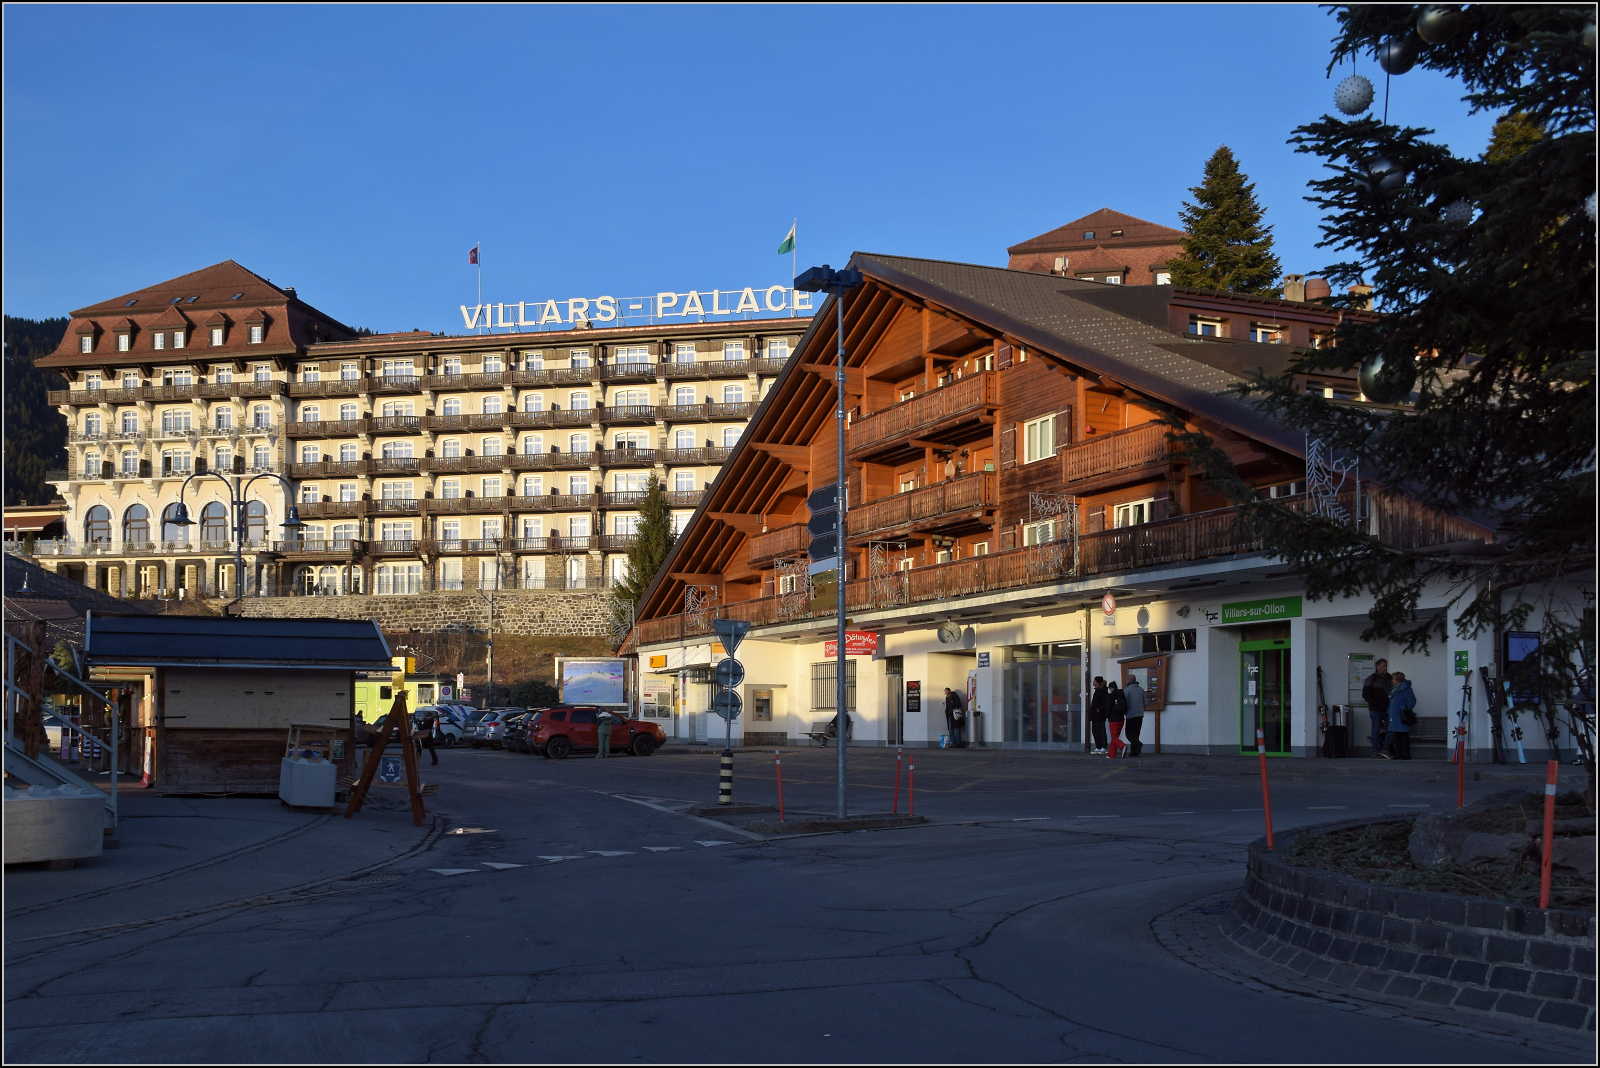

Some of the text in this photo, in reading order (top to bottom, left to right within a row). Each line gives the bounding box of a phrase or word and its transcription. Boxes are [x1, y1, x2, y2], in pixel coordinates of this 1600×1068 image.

[460, 295, 617, 330] VILLARS
[657, 285, 813, 318] PALACE
[1224, 604, 1285, 619] Villars-sur-Ollon
